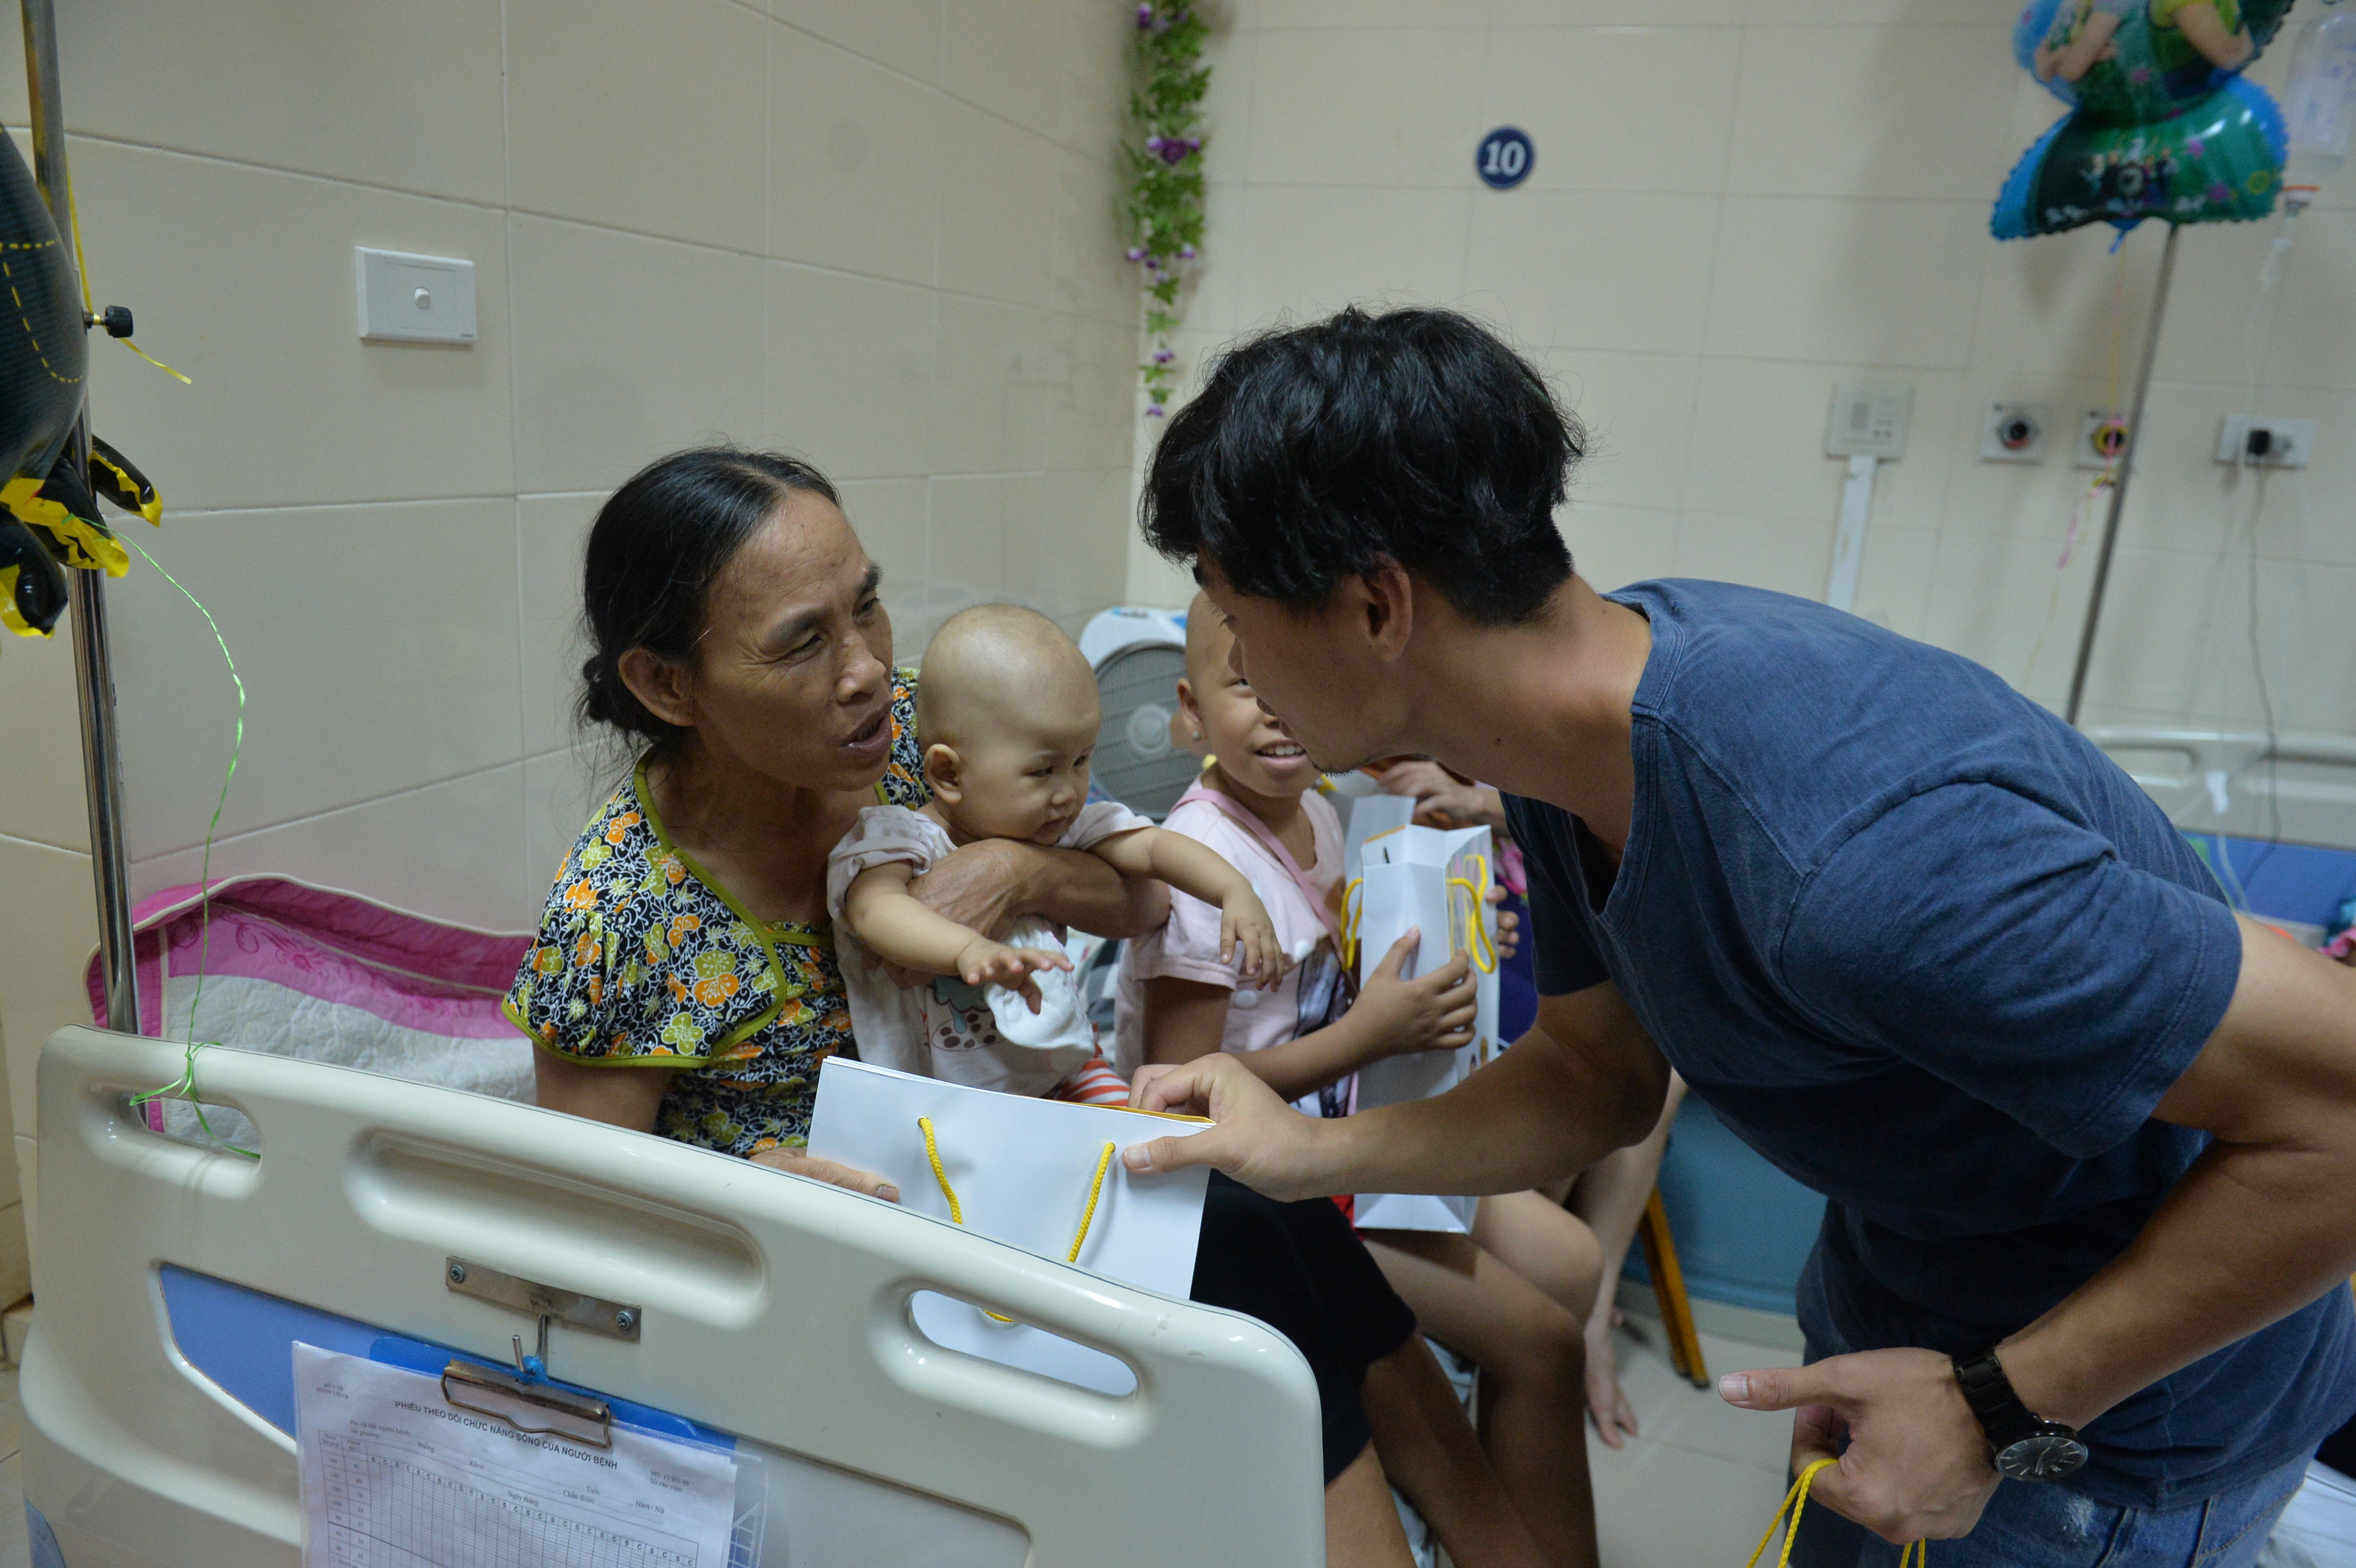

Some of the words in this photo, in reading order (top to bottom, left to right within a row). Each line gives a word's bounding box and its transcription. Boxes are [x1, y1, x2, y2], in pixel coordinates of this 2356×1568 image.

[1483, 140, 1526, 177] 10
[395, 1401, 421, 1412] PHIẾU
[423, 1406, 446, 1418] THEO
[463, 1418, 488, 1431] CHỨC
[490, 1424, 514, 1438] NĂNG
[516, 1433, 540, 1447] SỐNG
[542, 1440, 559, 1453] CỦA
[561, 1447, 591, 1462] NGƯỜI
[593, 1455, 618, 1470] BỆNH
[507, 1491, 522, 1502] Ngày
[523, 1496, 539, 1507] tháng
[635, 1500, 650, 1510] Nam
[654, 1506, 665, 1514] Nữ
